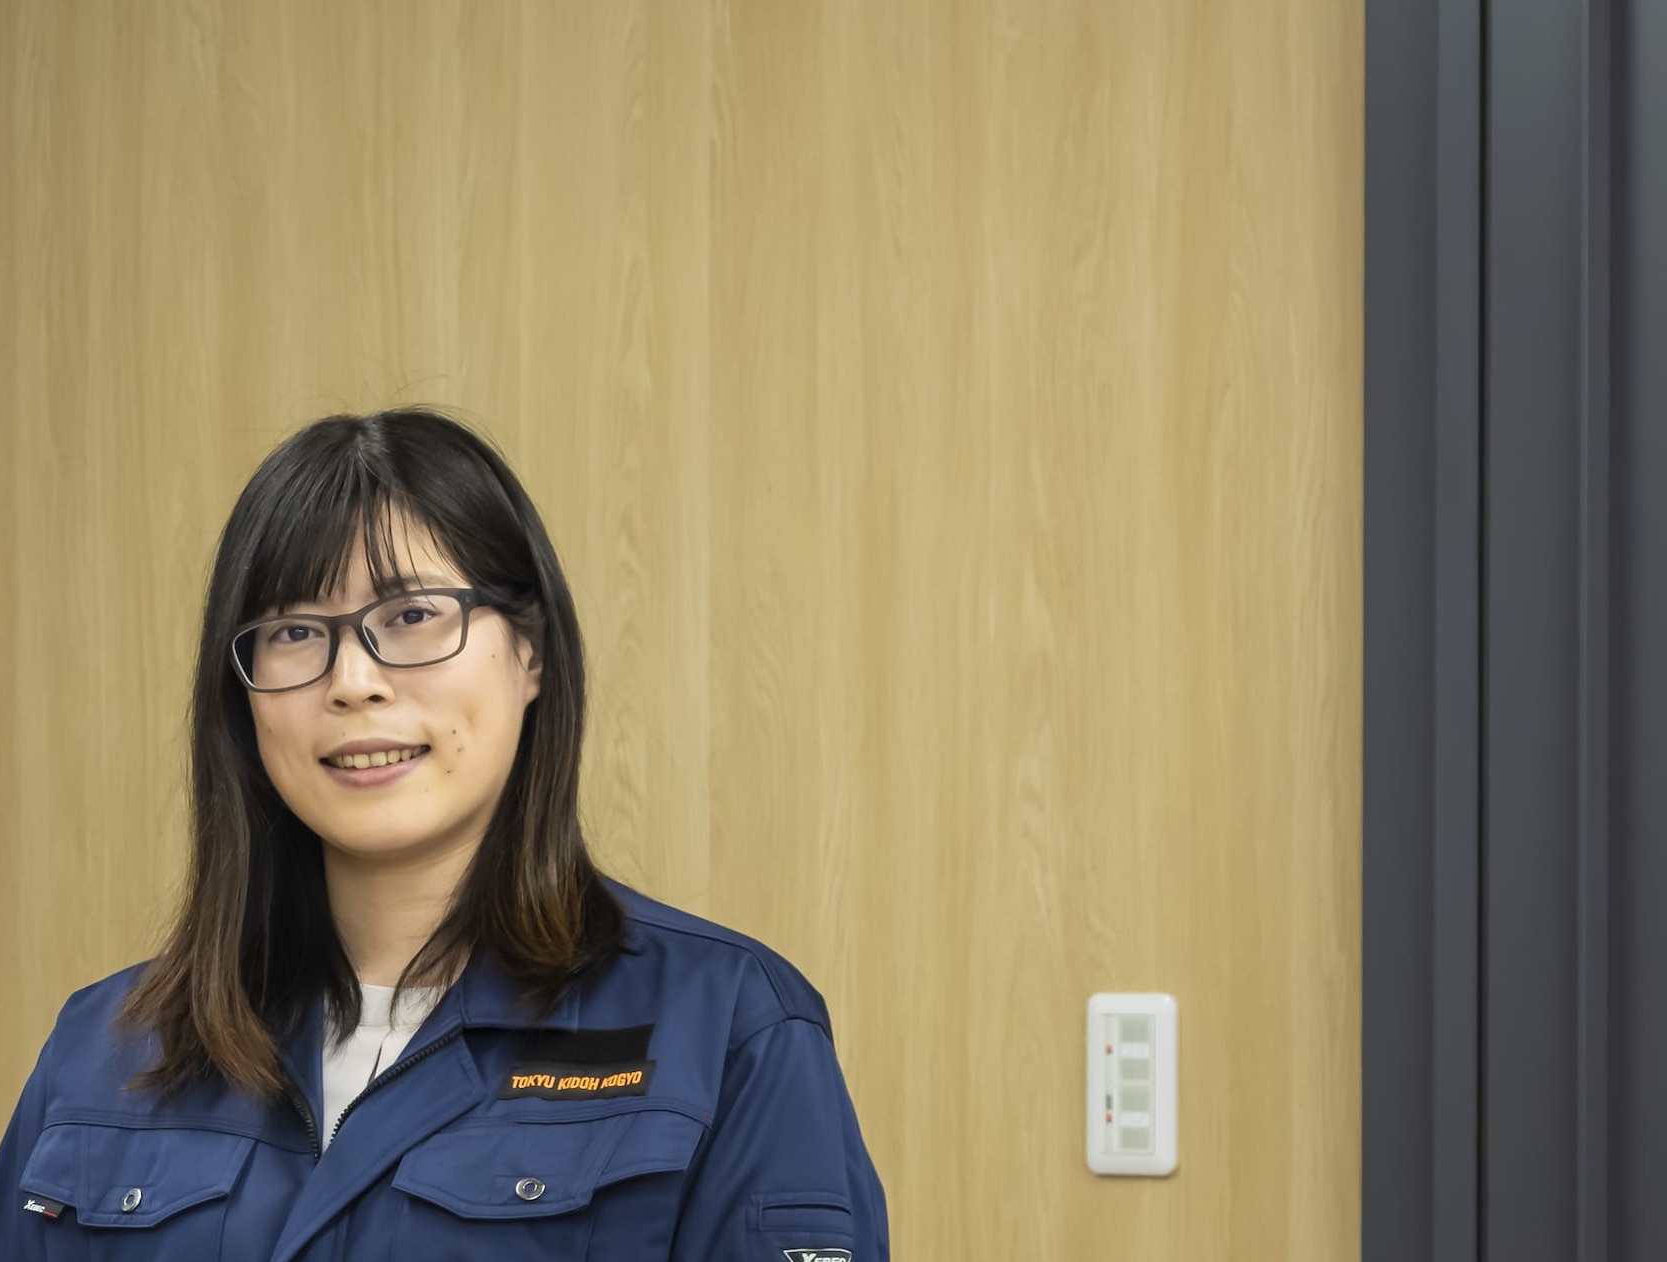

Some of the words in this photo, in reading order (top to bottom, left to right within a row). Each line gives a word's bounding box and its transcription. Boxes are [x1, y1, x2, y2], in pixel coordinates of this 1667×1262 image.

[511, 1073, 555, 1089] TOKYU
[557, 1077, 600, 1090] KIDOH
[600, 1070, 643, 1089] KOGYO
